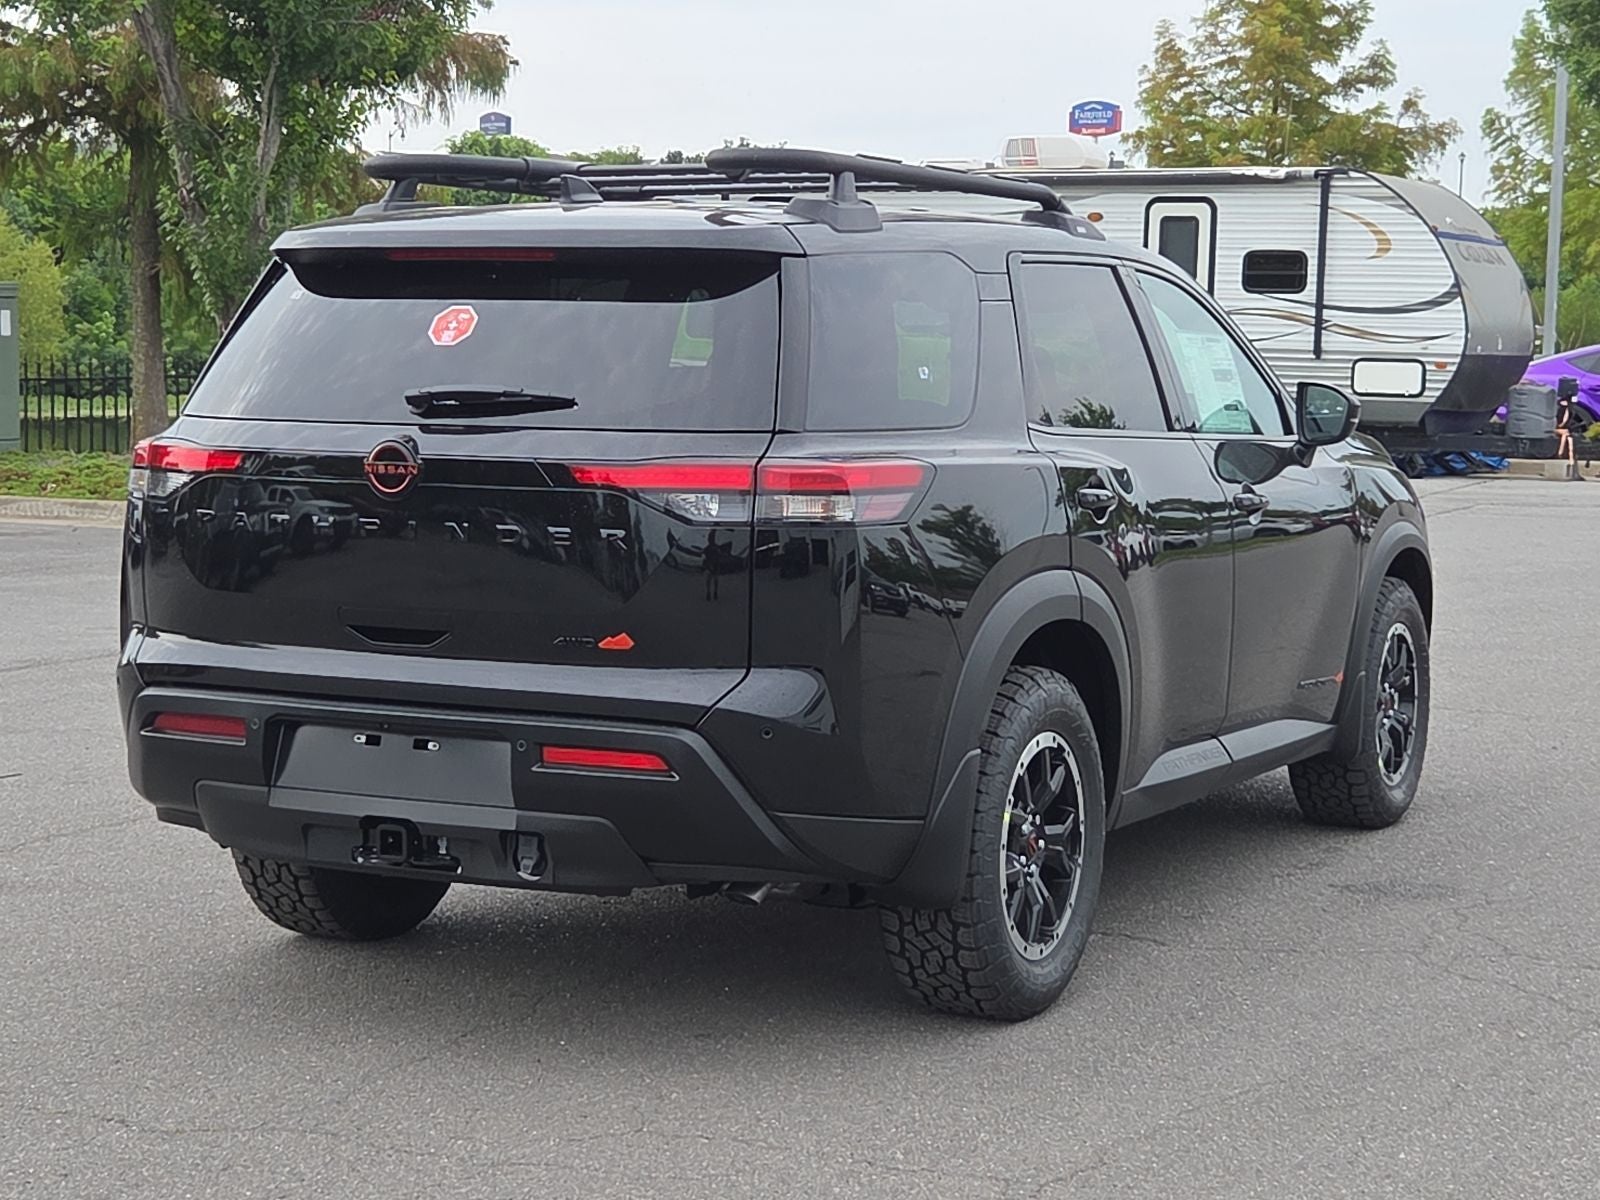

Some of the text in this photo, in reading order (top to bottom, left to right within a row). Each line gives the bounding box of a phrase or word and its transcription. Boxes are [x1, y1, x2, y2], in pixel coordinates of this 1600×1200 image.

[1075, 109, 1113, 120] FAIRFIELD
[364, 463, 418, 475] NISSAN
[196, 508, 629, 550] PATHFINDER
